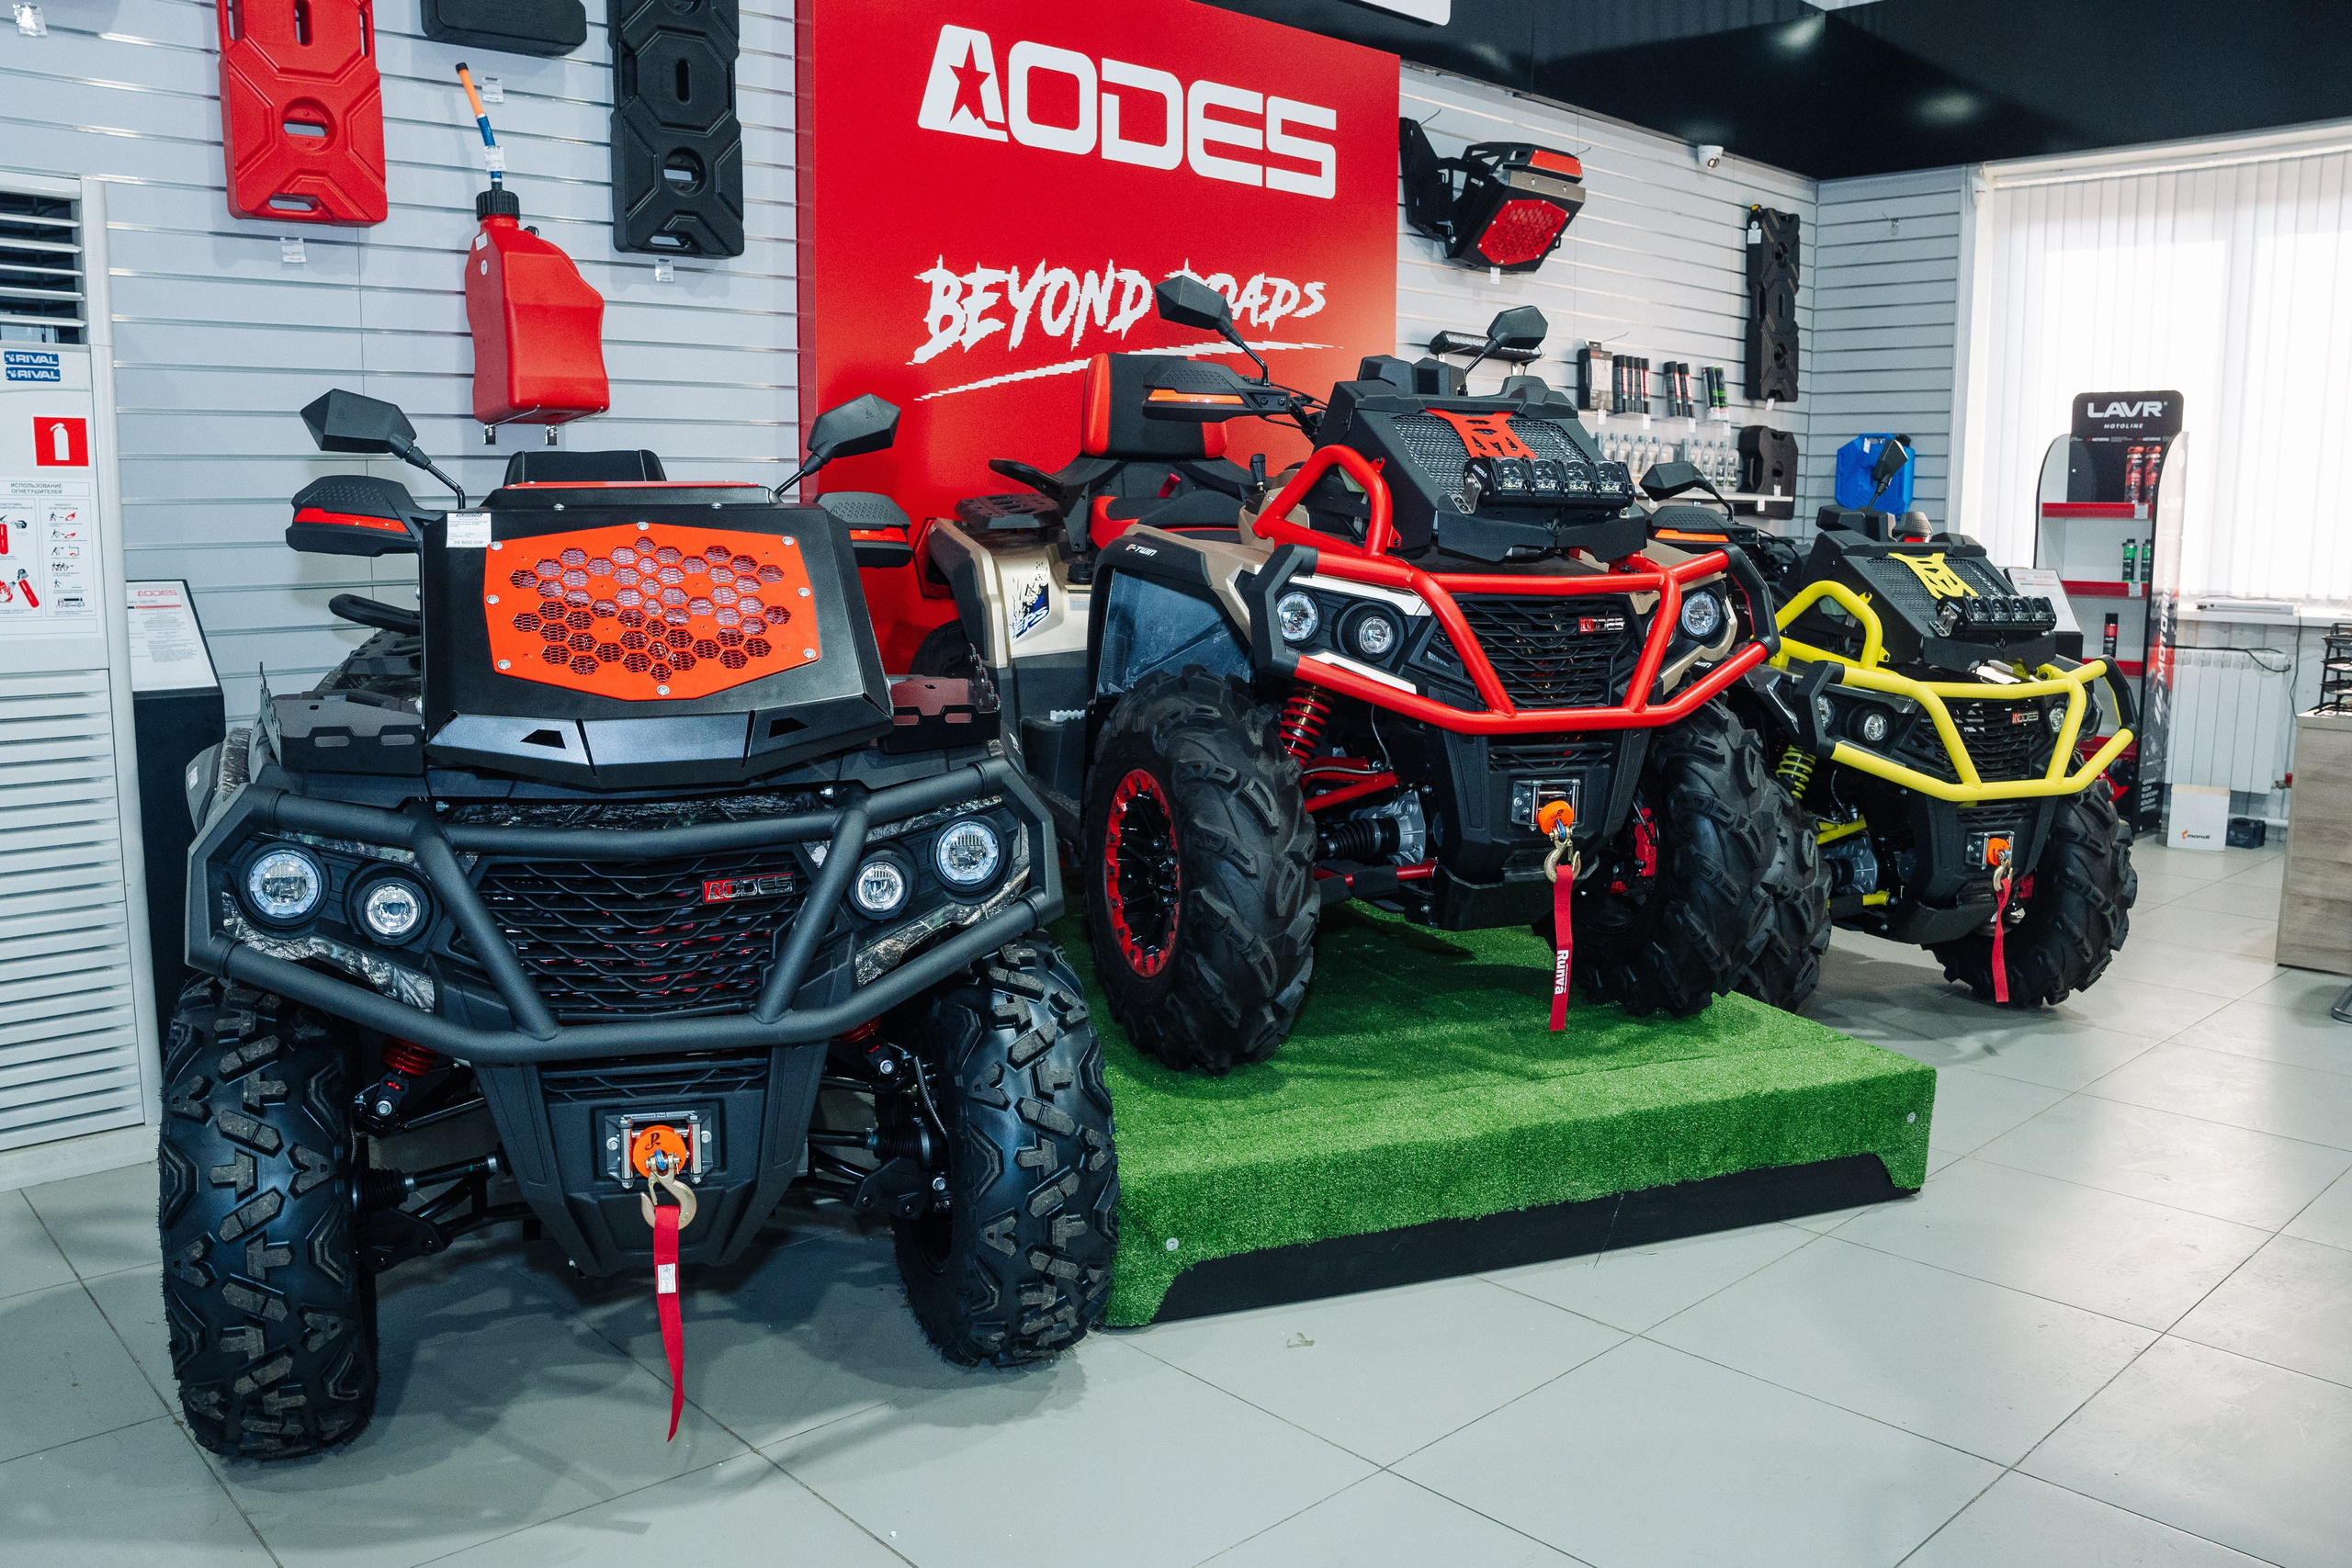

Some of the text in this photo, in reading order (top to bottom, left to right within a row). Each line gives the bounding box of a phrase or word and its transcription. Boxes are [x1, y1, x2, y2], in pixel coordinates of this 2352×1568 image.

[917, 24, 1337, 199] AODES
[905, 254, 1328, 365] BEYOND OADS
[16, 355, 58, 365] RIVAL
[17, 370, 59, 379] RIVAL
[2087, 400, 2163, 418] LAVR
[1014, 606, 1049, 637] EPS
[707, 875, 793, 900] AODES
[1555, 950, 1569, 995] Runva
